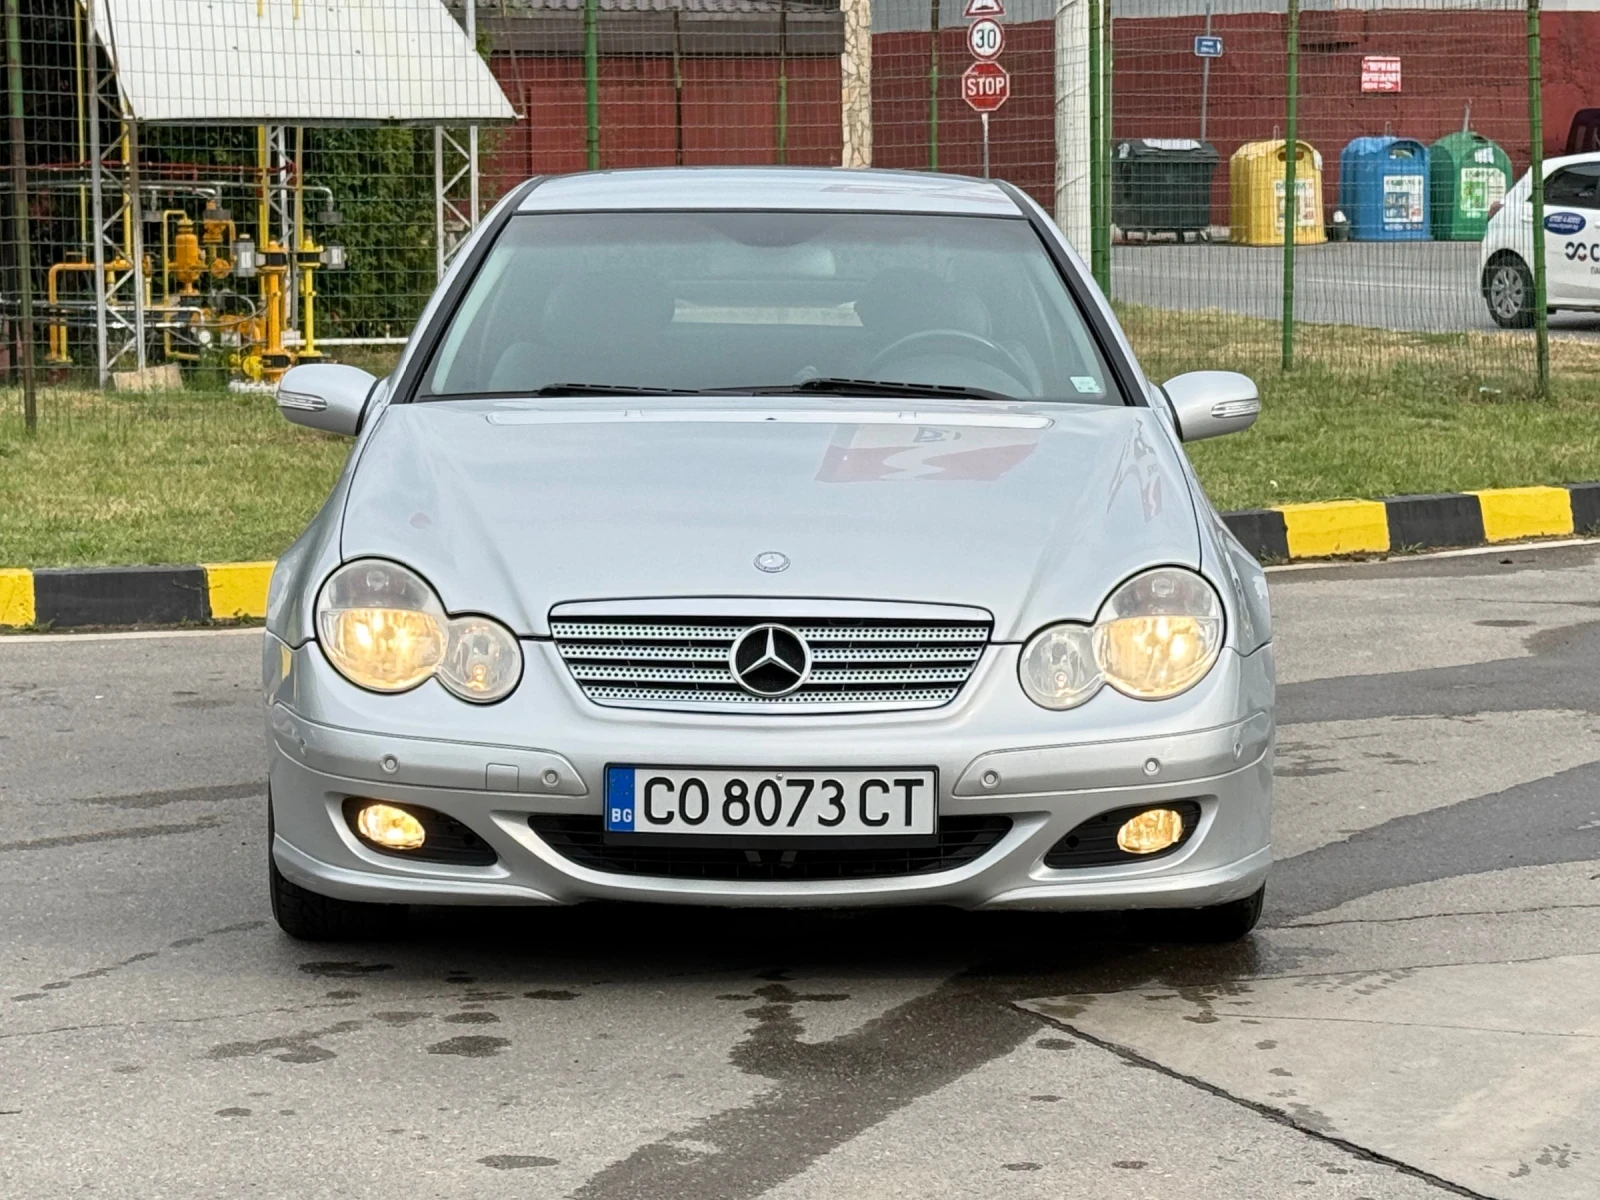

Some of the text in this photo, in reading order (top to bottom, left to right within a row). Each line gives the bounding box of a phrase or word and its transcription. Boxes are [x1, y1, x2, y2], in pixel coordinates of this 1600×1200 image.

[975, 29, 997, 49] 30
[967, 77, 1005, 96] STOP
[611, 776, 924, 827] BG CO 8073 CT
